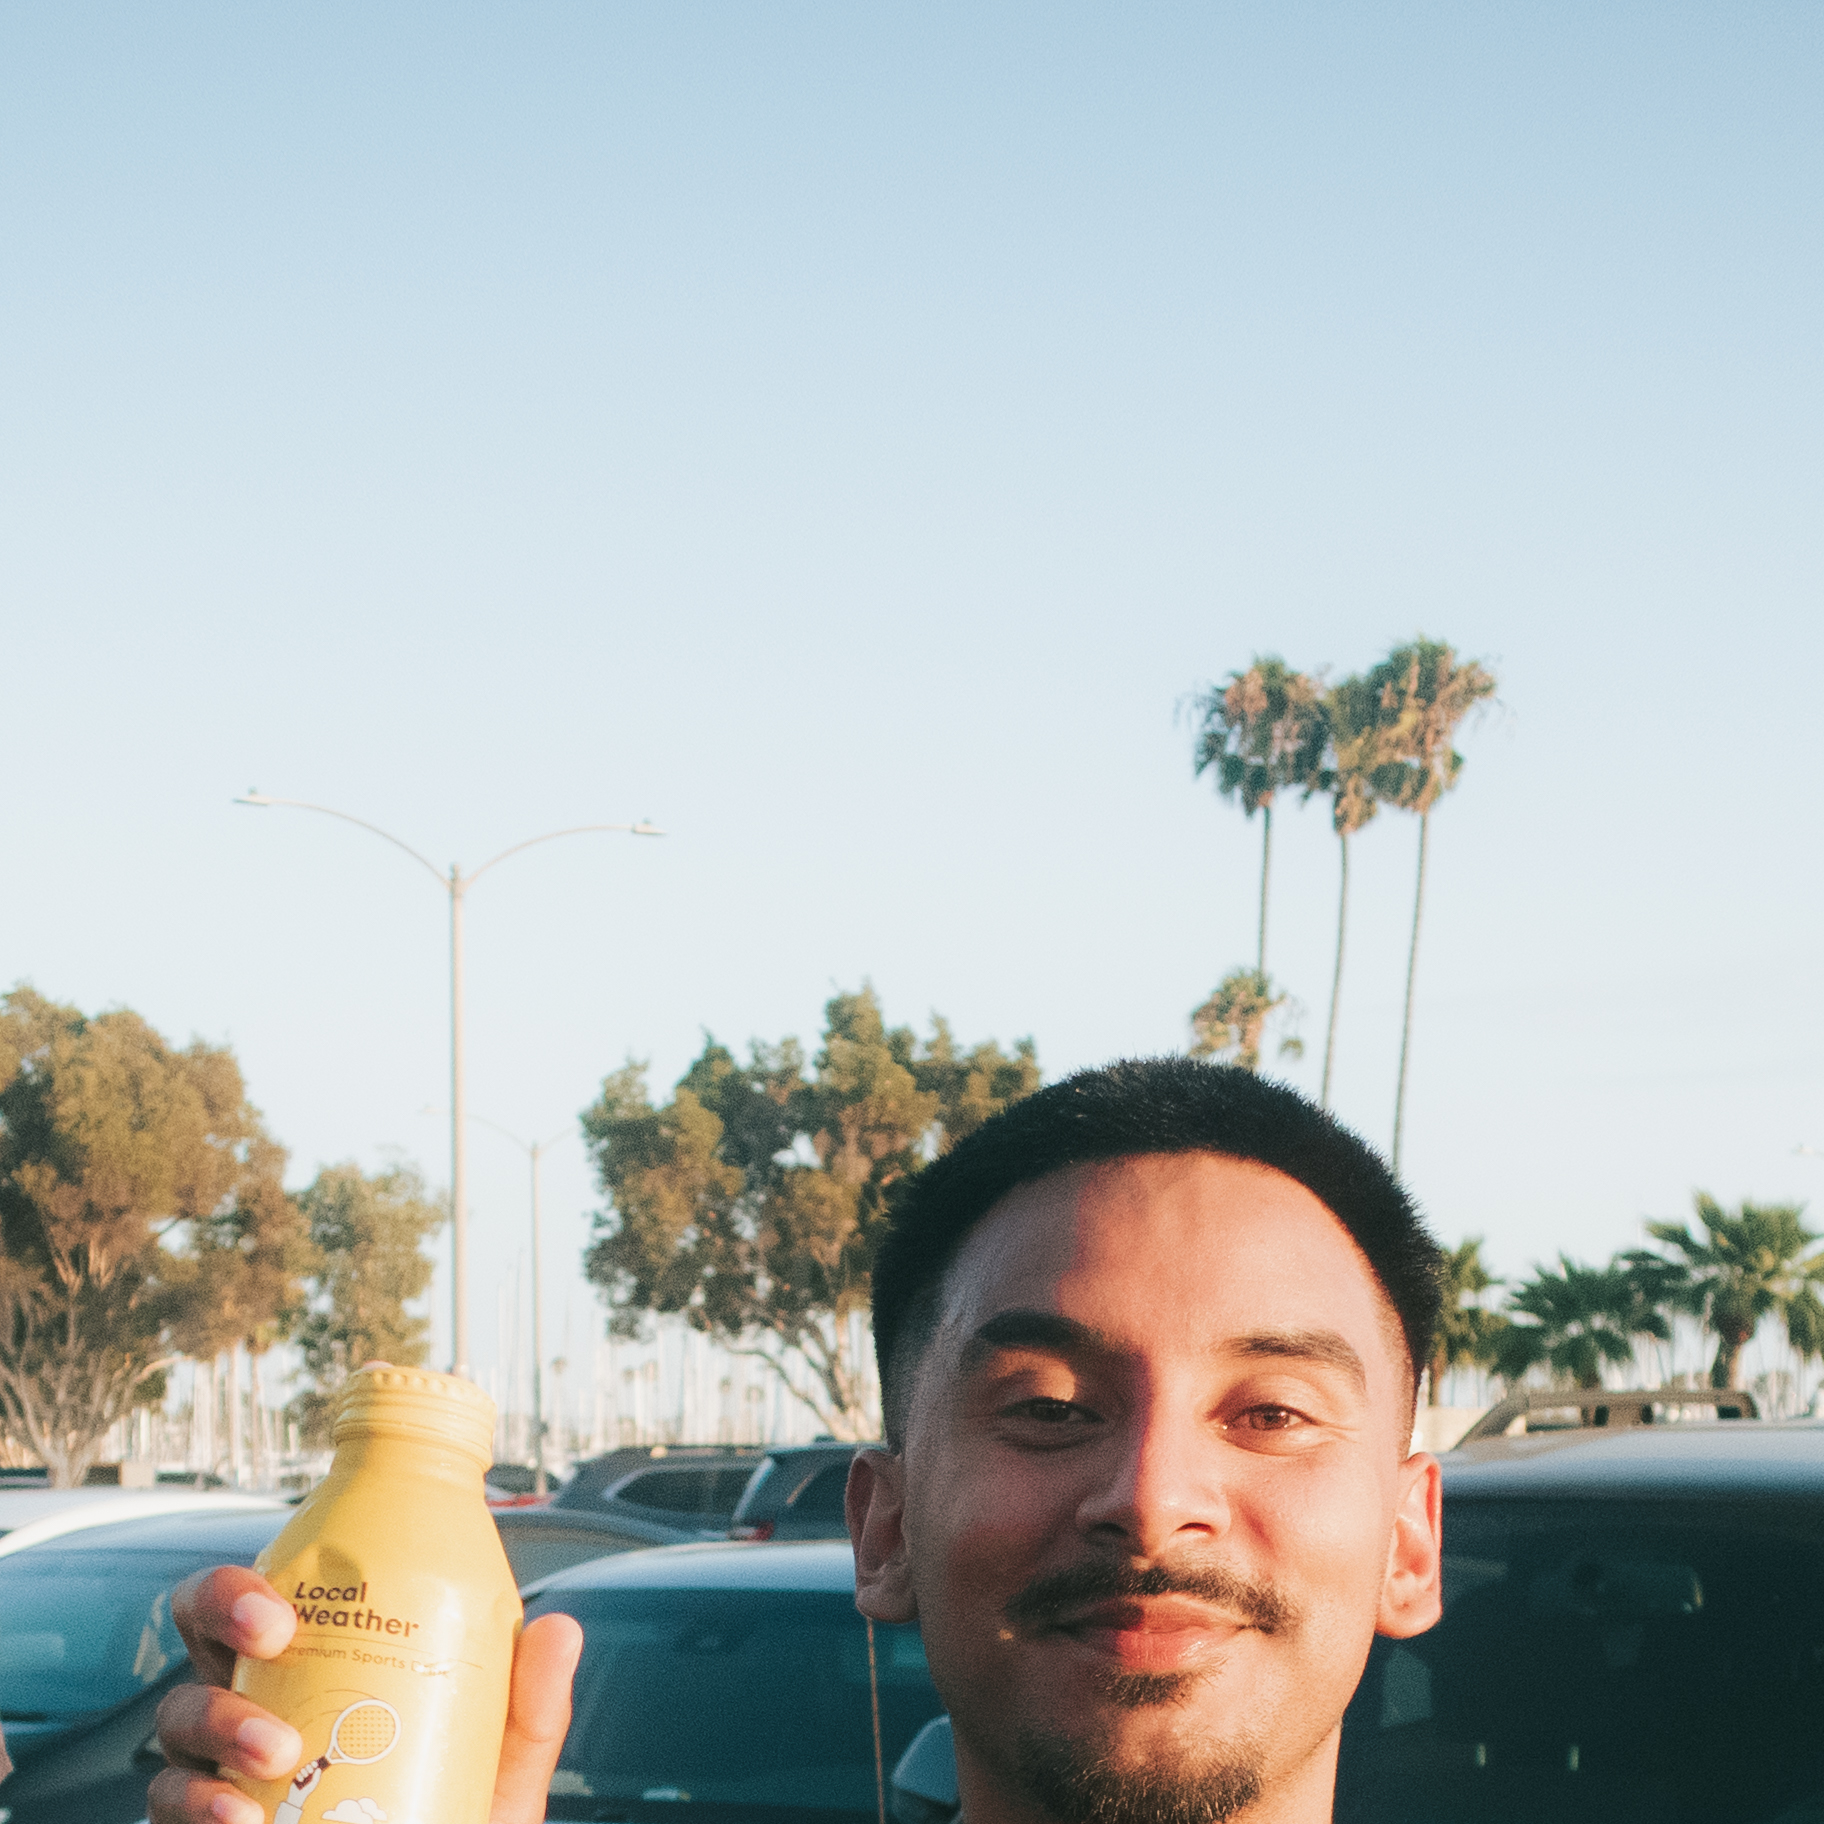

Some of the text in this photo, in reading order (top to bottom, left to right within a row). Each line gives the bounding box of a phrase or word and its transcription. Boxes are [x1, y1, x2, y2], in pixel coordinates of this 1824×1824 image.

[295, 1581, 368, 1603] Local
[292, 1604, 419, 1637] Weather
[352, 1649, 406, 1670] Sports
